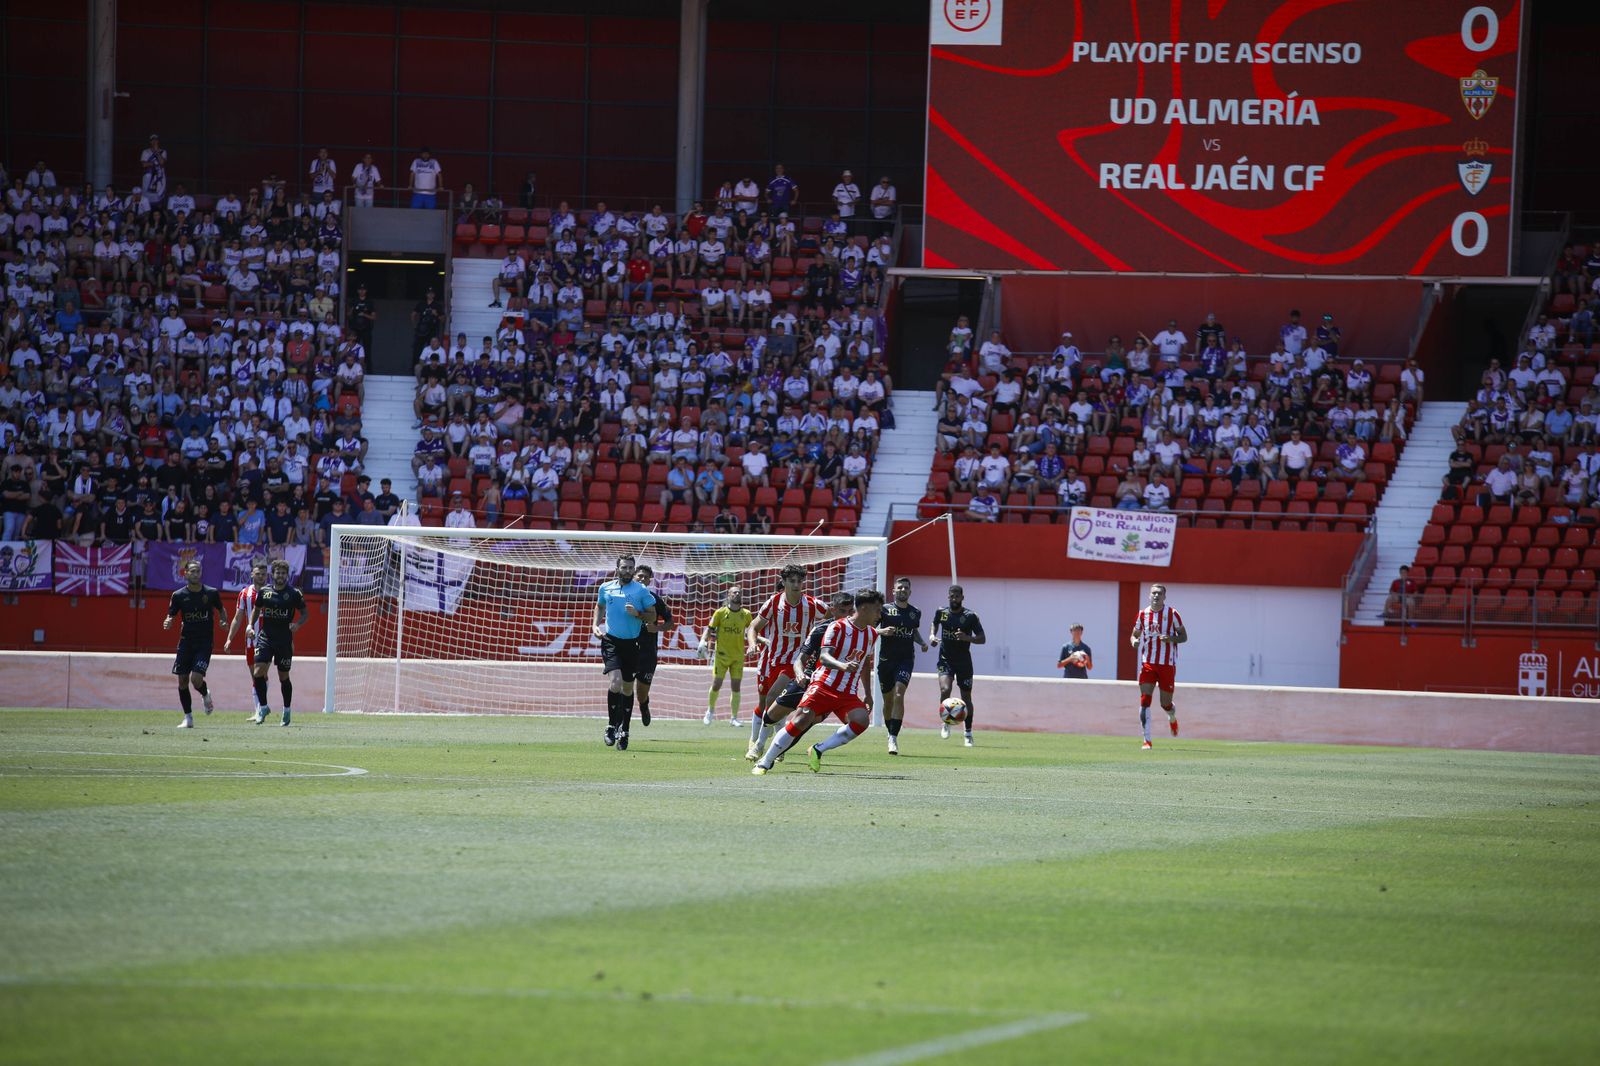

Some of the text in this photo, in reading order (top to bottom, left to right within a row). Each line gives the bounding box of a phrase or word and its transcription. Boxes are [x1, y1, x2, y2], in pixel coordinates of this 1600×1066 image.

[1461, 6, 1499, 52] 0
[1072, 41, 1362, 64] PLAYOFF DE ASCENSO
[1110, 90, 1321, 126] UD ALMERÍA
[1100, 155, 1325, 192] REAL JAÉN CF
[1451, 211, 1489, 257] 0
[1095, 520, 1113, 529] DEL
[1136, 514, 1175, 524] AMIGOS
